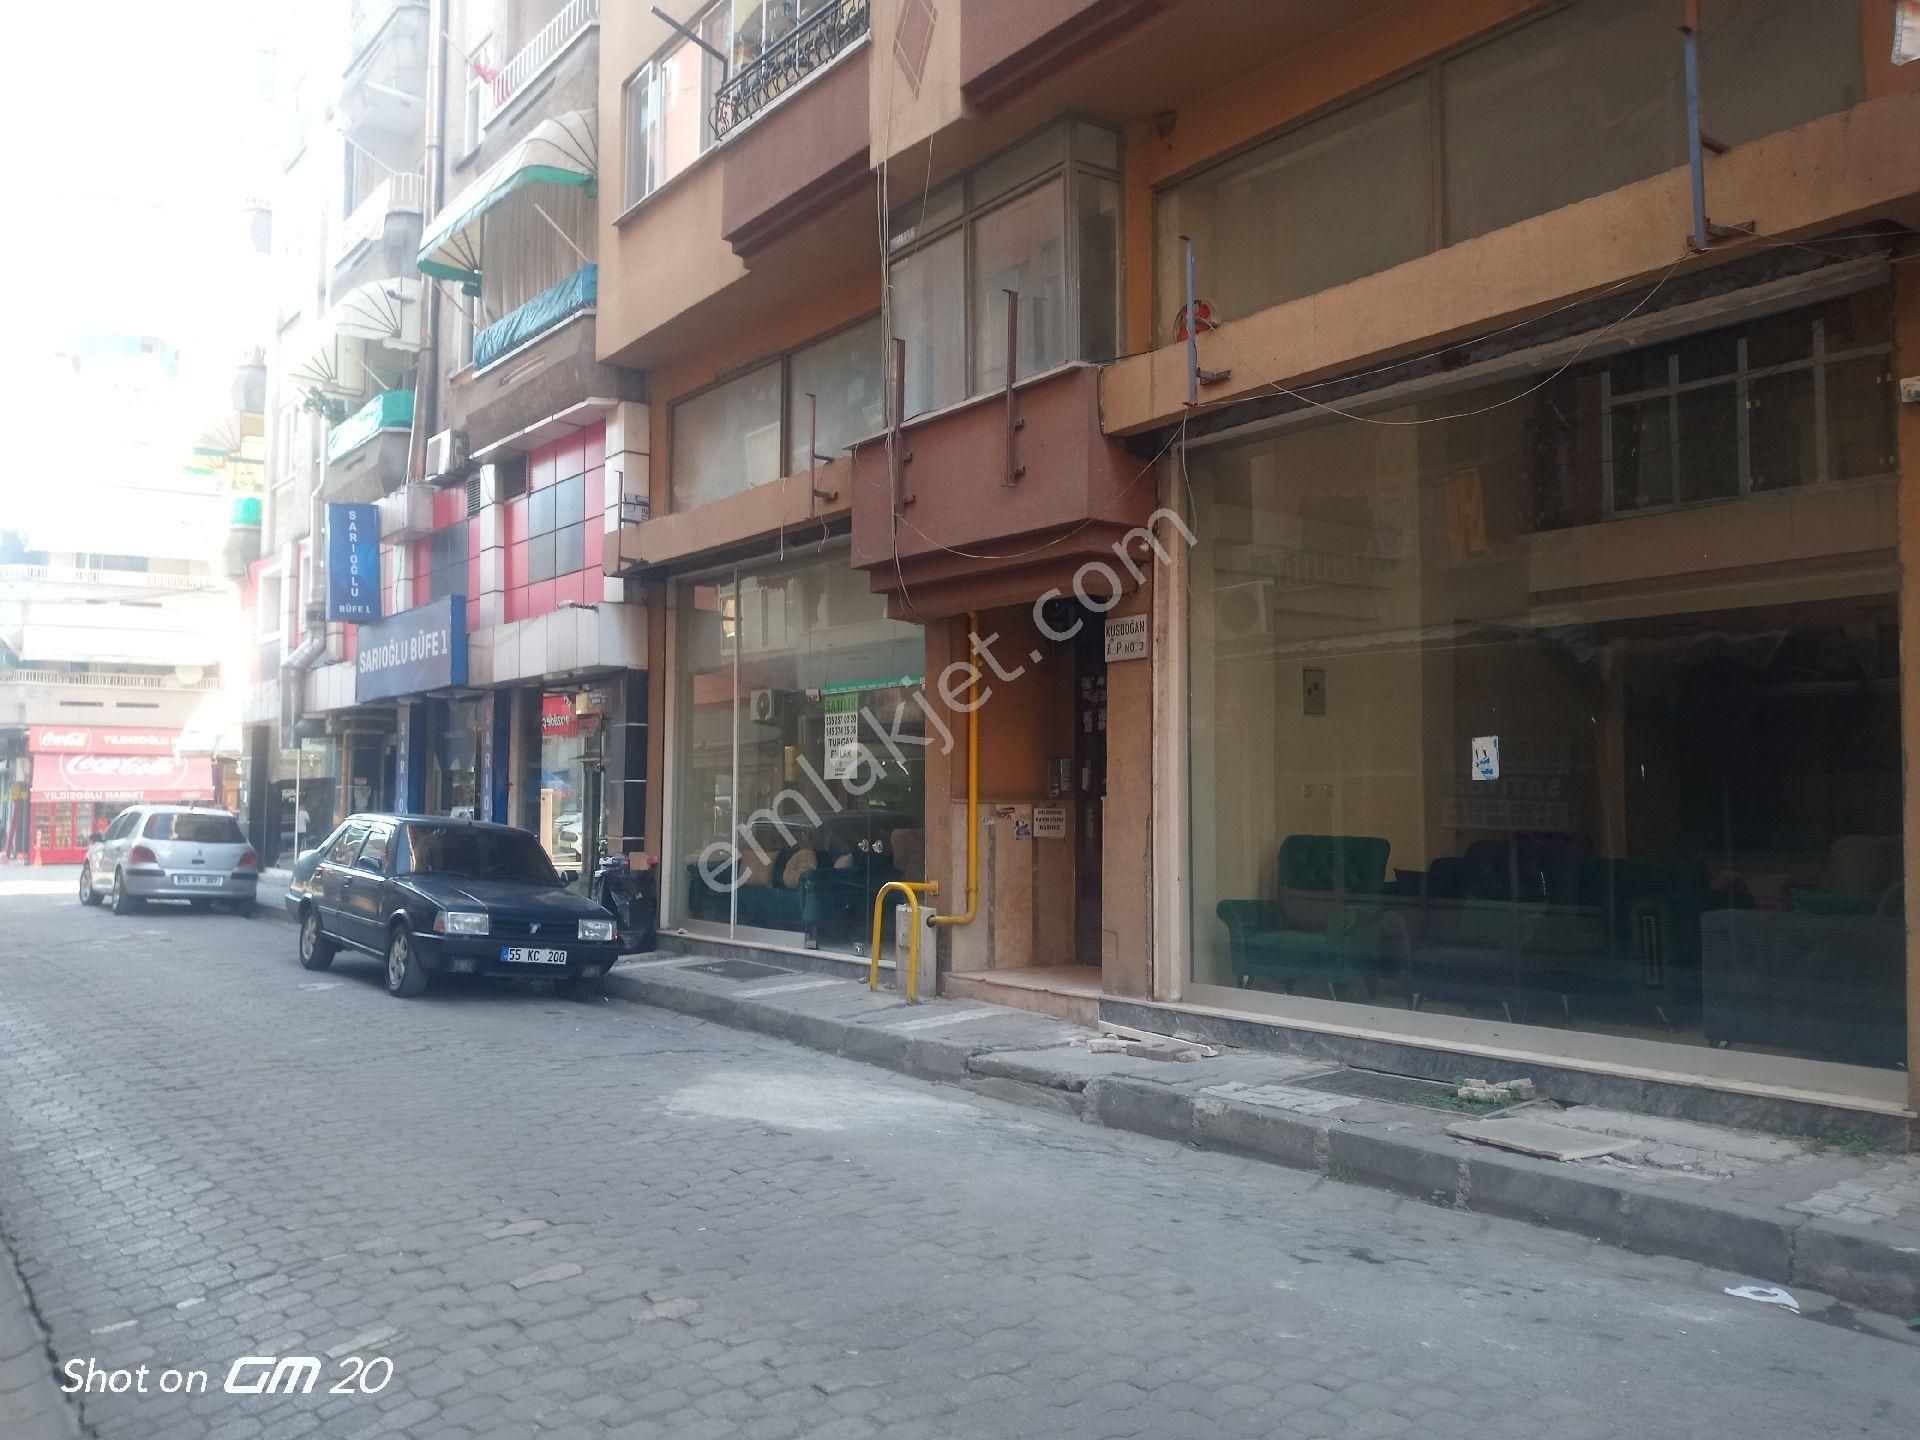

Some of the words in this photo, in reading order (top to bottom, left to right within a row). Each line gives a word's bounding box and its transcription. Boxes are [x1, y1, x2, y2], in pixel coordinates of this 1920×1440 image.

[339, 604, 363, 613] BÜFE
[366, 605, 371, 613] 1
[359, 638, 408, 674] SARIOĞLU
[410, 629, 439, 662] BÜFE
[441, 630, 448, 655] 1
[105, 791, 144, 799] MARKET
[509, 949, 521, 960] 55
[527, 949, 540, 961] KC
[547, 951, 565, 962] 200
